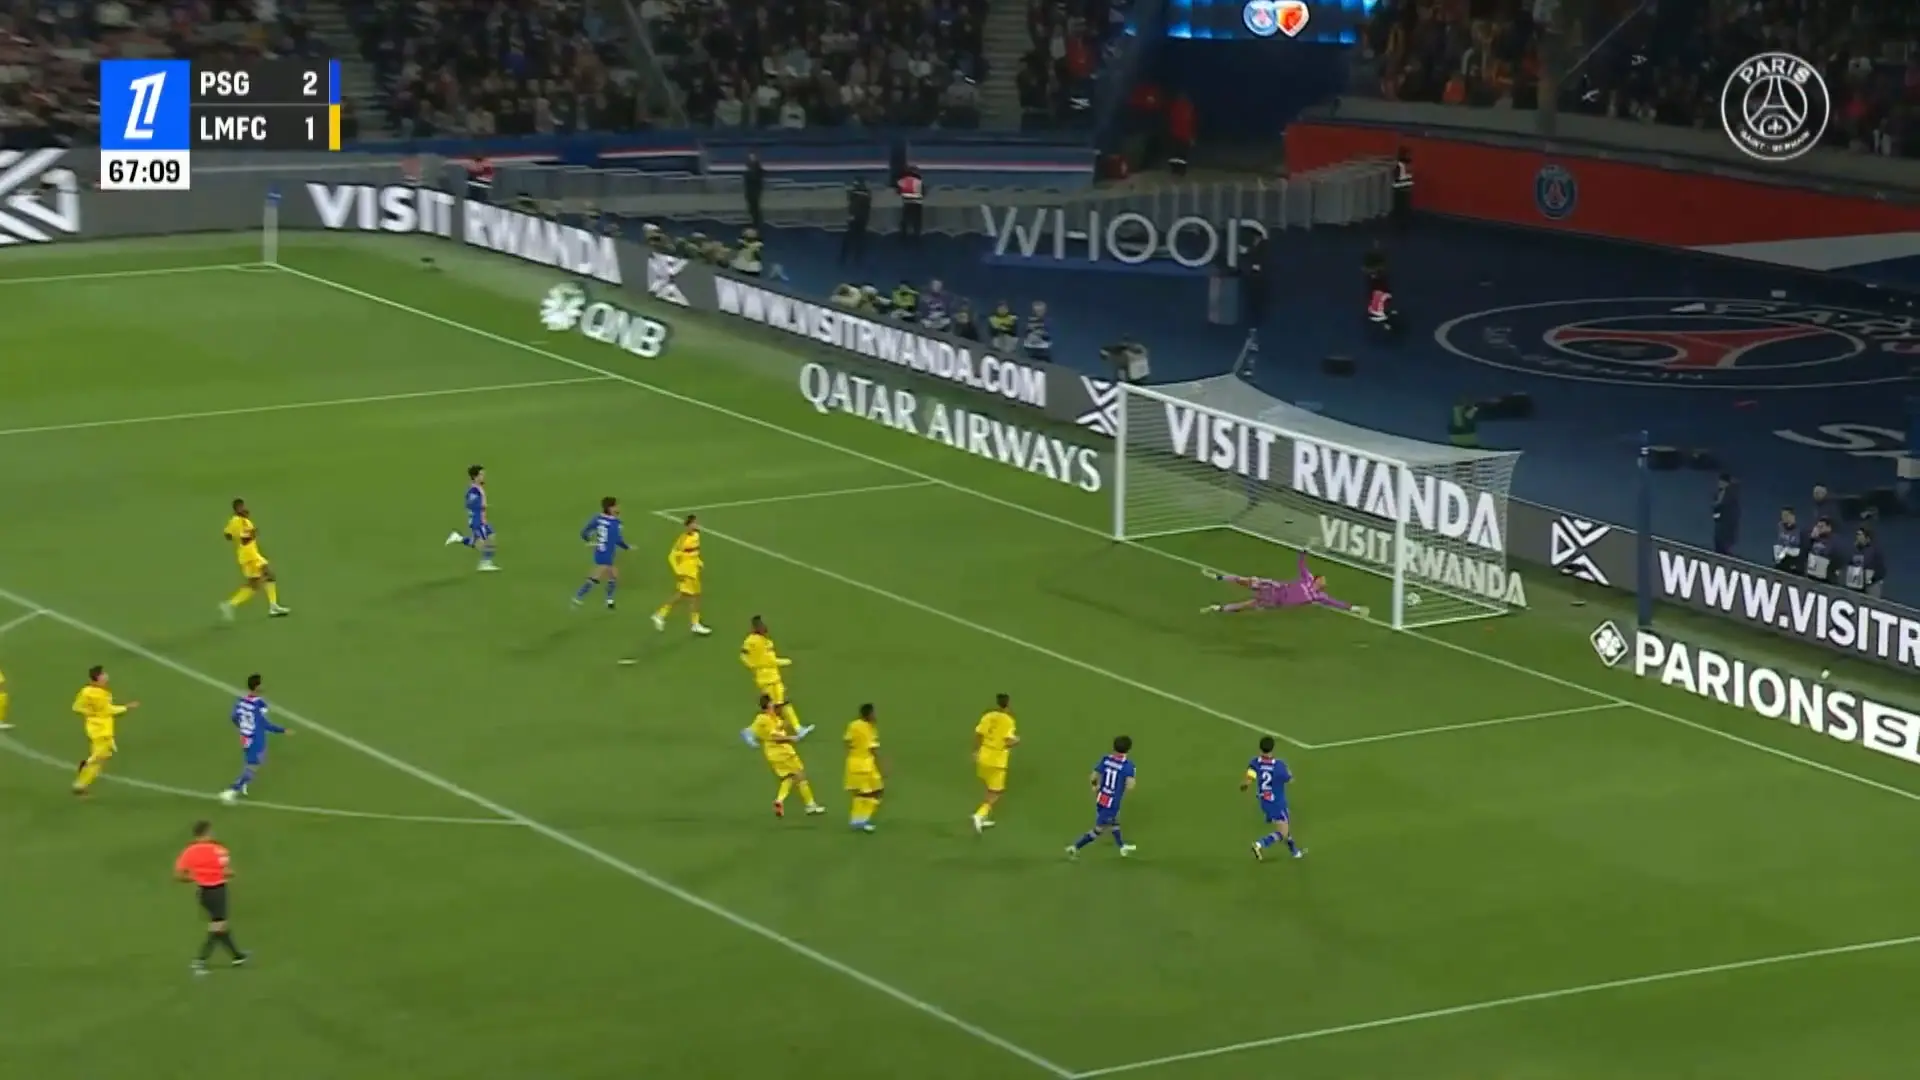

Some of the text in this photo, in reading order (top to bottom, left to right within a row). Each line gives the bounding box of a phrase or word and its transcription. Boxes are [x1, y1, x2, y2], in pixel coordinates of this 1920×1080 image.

[305, 183, 622, 285] VISIT RWANDA
[981, 204, 1268, 268] WHOOP
[580, 302, 666, 357] QNB
[714, 275, 1047, 407] WWW.VISITRWANDA.COM
[800, 362, 1101, 492] QATAR AIRWAYS
[1165, 401, 1502, 551] VISIT RWANDA
[1319, 514, 1527, 608] VISIT RWANDA
[1658, 550, 1920, 667] WWW.VISITR
[1635, 630, 1858, 741] PARIONS
[1105, 768, 1117, 790] 11
[1262, 771, 1272, 790] 2
